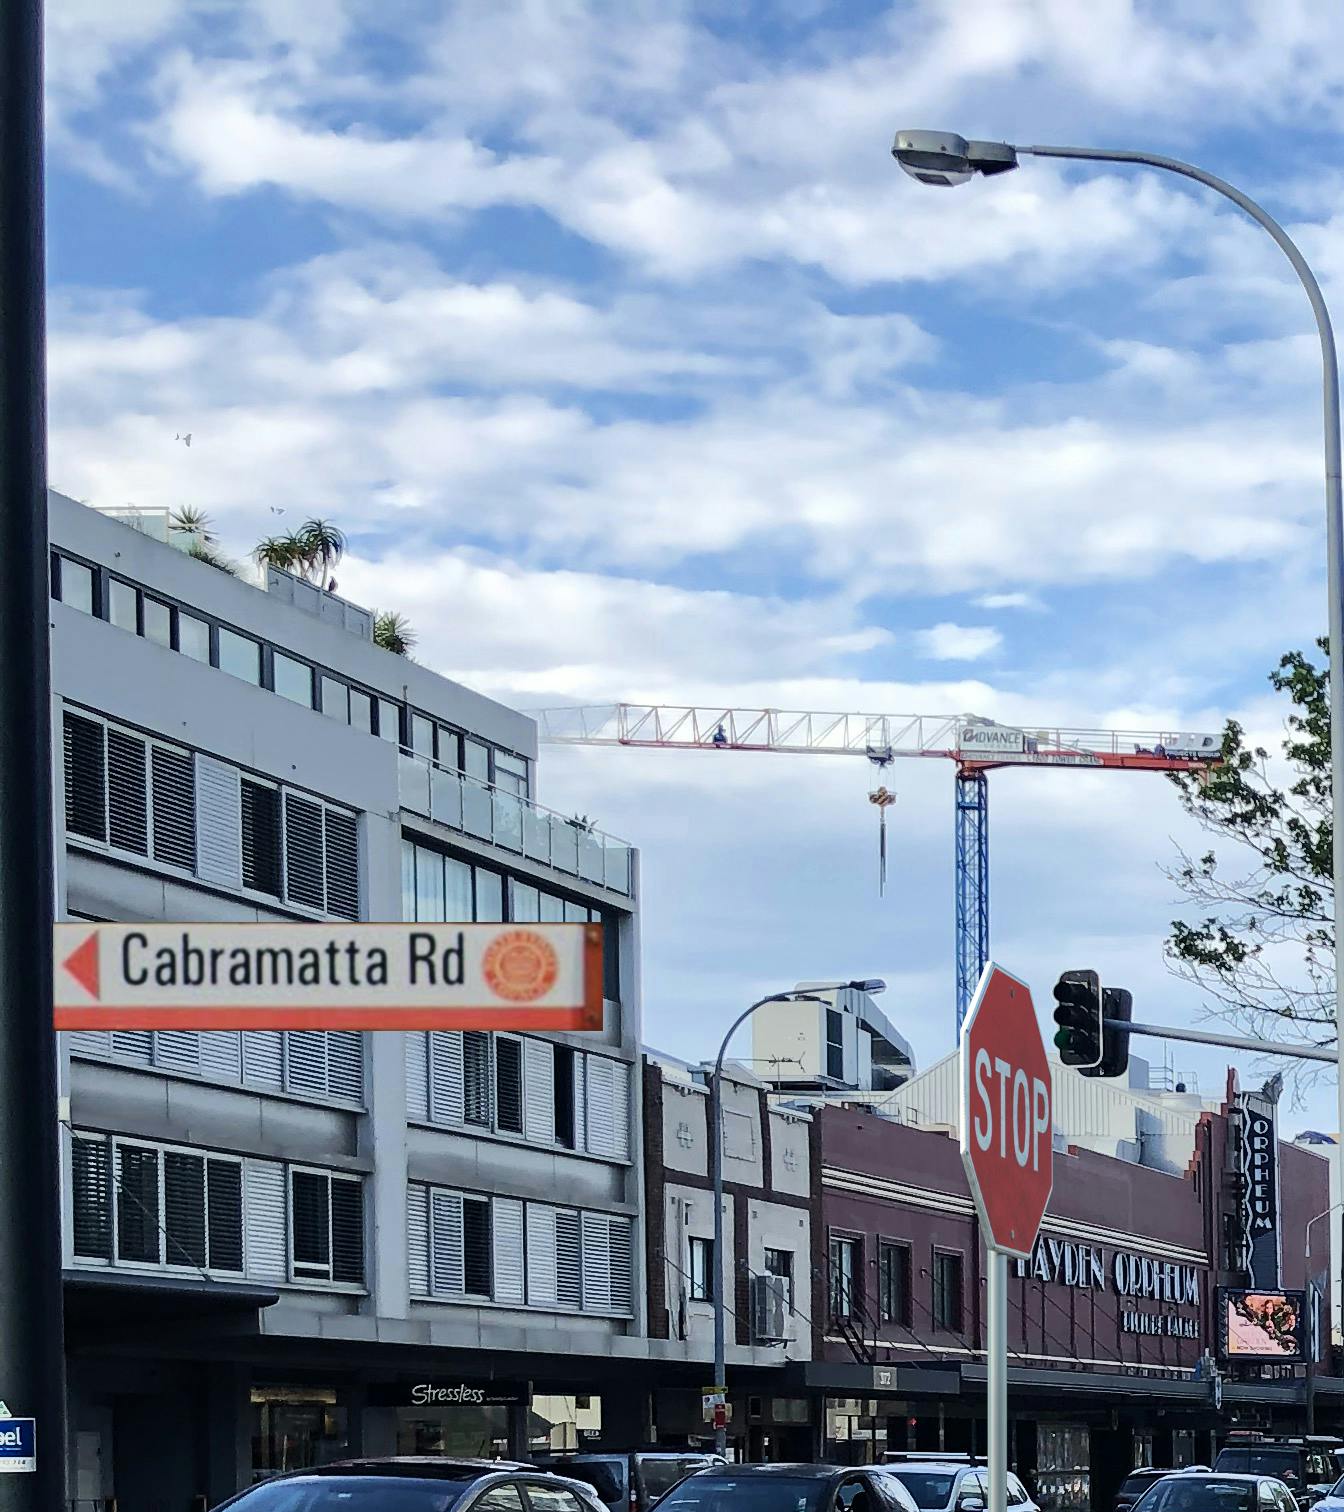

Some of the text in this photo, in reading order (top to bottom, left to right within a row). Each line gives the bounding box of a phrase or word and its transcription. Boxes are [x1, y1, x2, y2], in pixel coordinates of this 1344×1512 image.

[121, 932, 389, 987] Cabramatta
[408, 932, 466, 987] Rd
[974, 1047, 1050, 1172] STOP
[1253, 1120, 1272, 1229] ORPHEUM
[1115, 1252, 1200, 1306] ORPHEUM
[411, 1384, 485, 1404] Stressless
